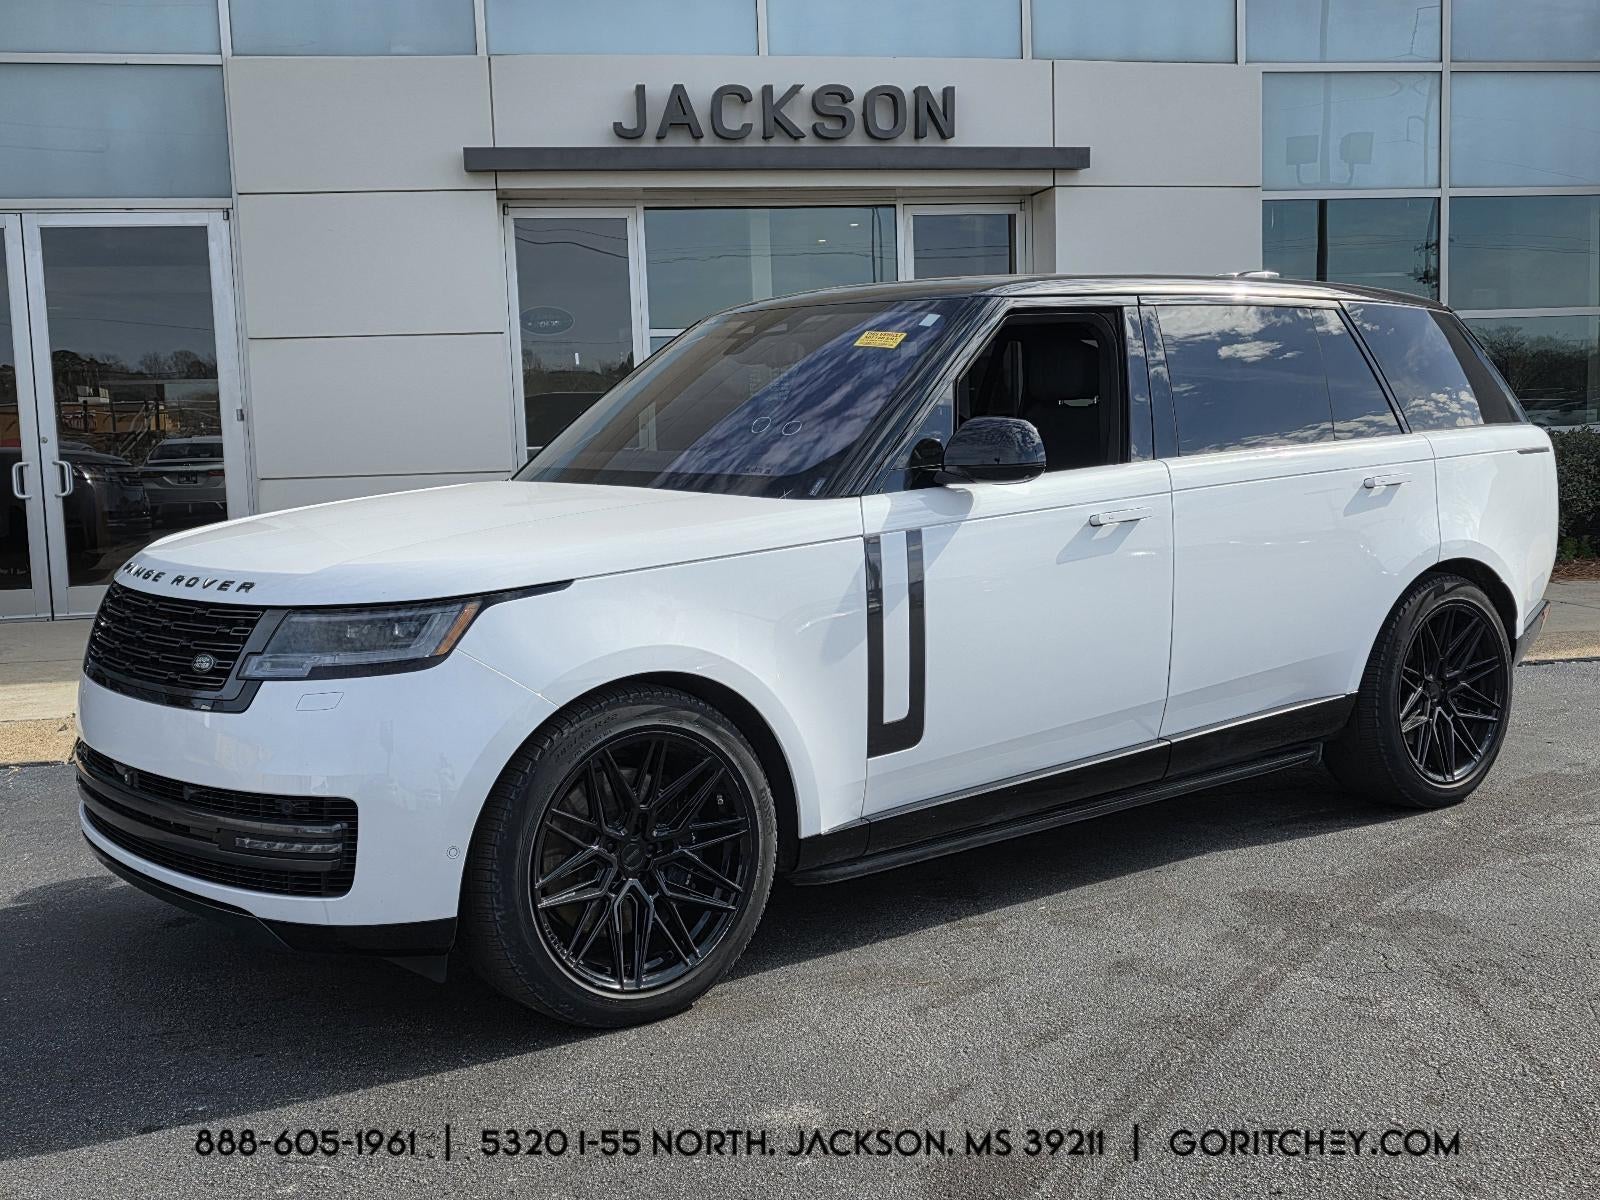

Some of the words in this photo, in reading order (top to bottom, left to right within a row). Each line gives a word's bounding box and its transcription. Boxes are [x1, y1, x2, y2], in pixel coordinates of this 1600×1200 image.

[612, 83, 956, 141] JACKSON
[122, 561, 166, 582] RANGE
[170, 574, 256, 594] ROVER
